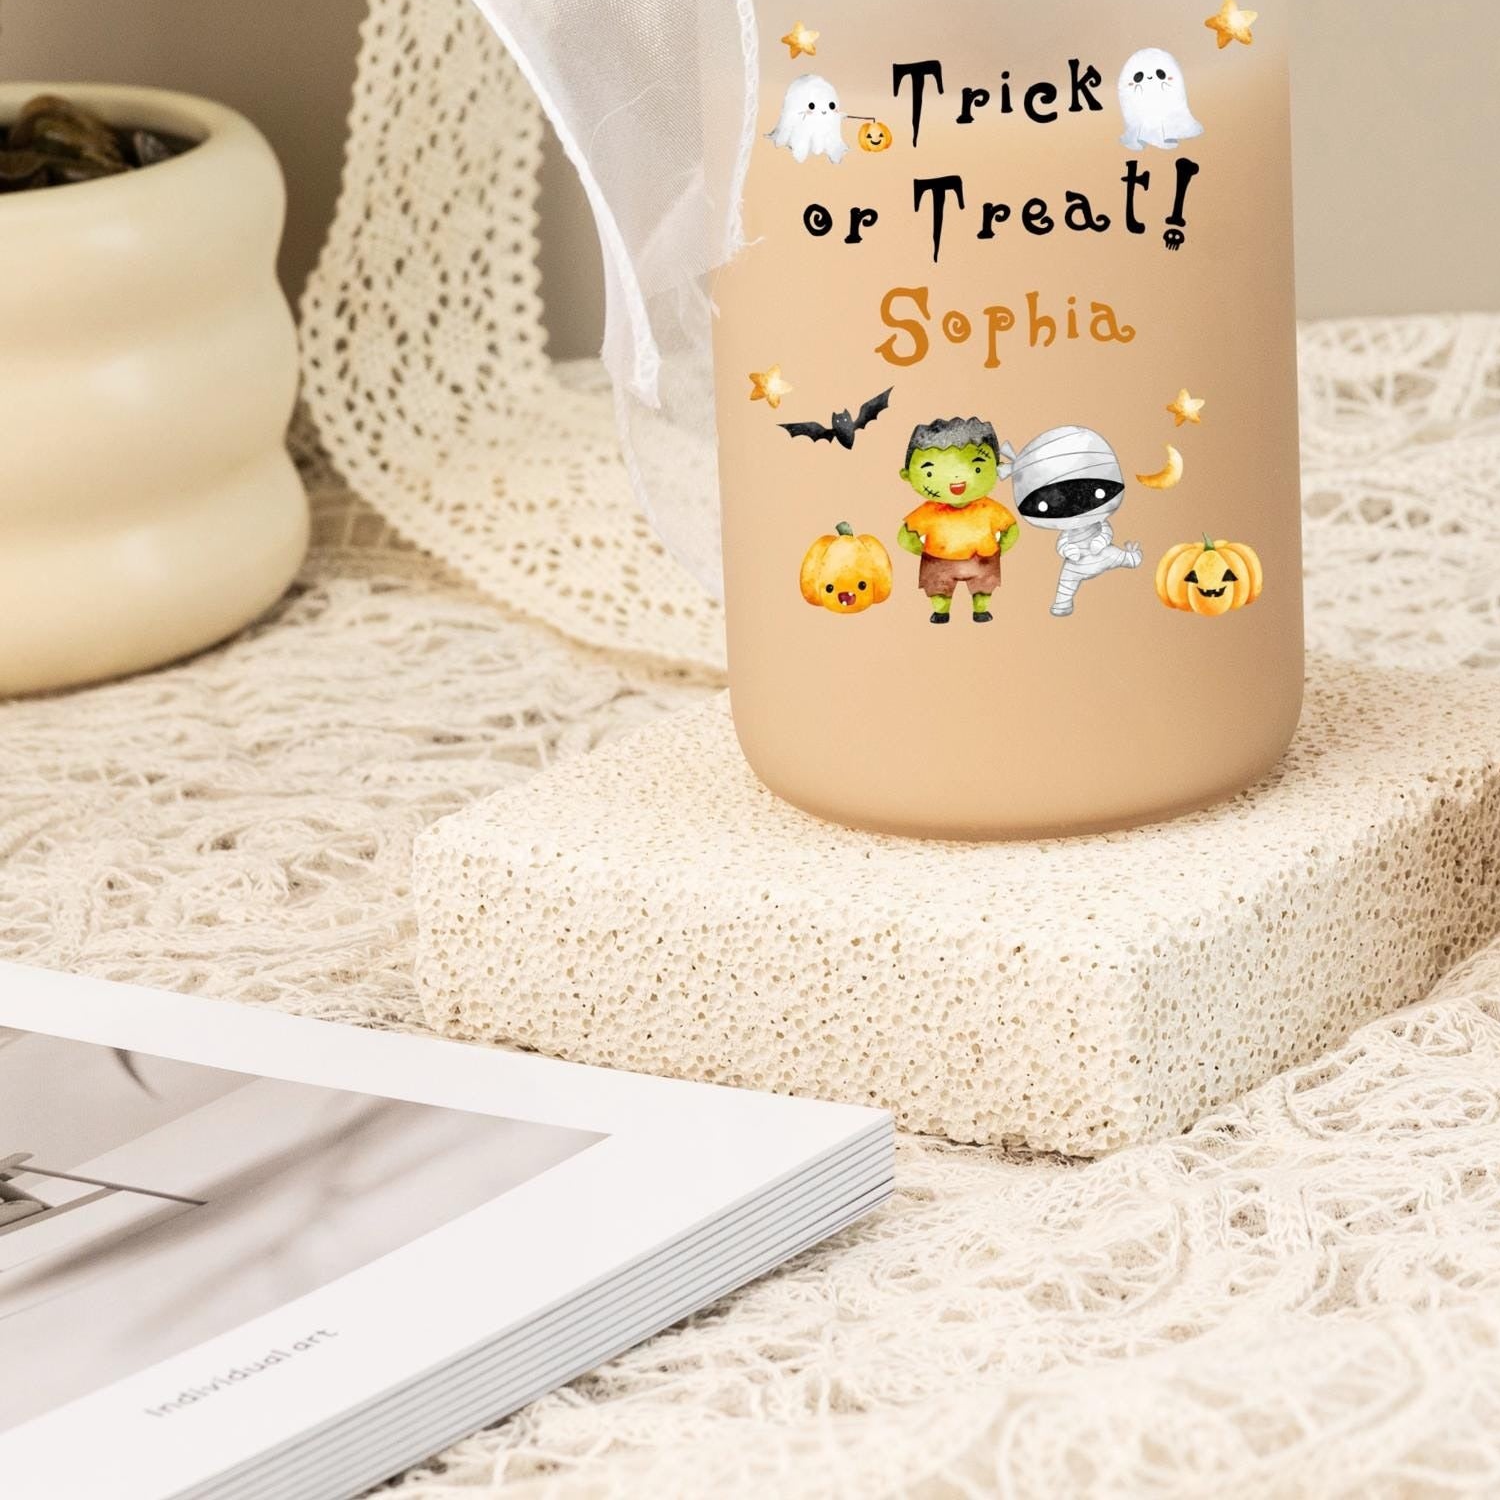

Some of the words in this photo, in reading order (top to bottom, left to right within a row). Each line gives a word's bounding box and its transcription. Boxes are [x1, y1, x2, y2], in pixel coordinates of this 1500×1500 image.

[892, 59, 1104, 148] Trick
[803, 203, 879, 244] or
[913, 158, 1200, 263] Treat!
[874, 287, 1136, 369] Sophia
[144, 1349, 292, 1419] Individual
[293, 1328, 338, 1352] art
